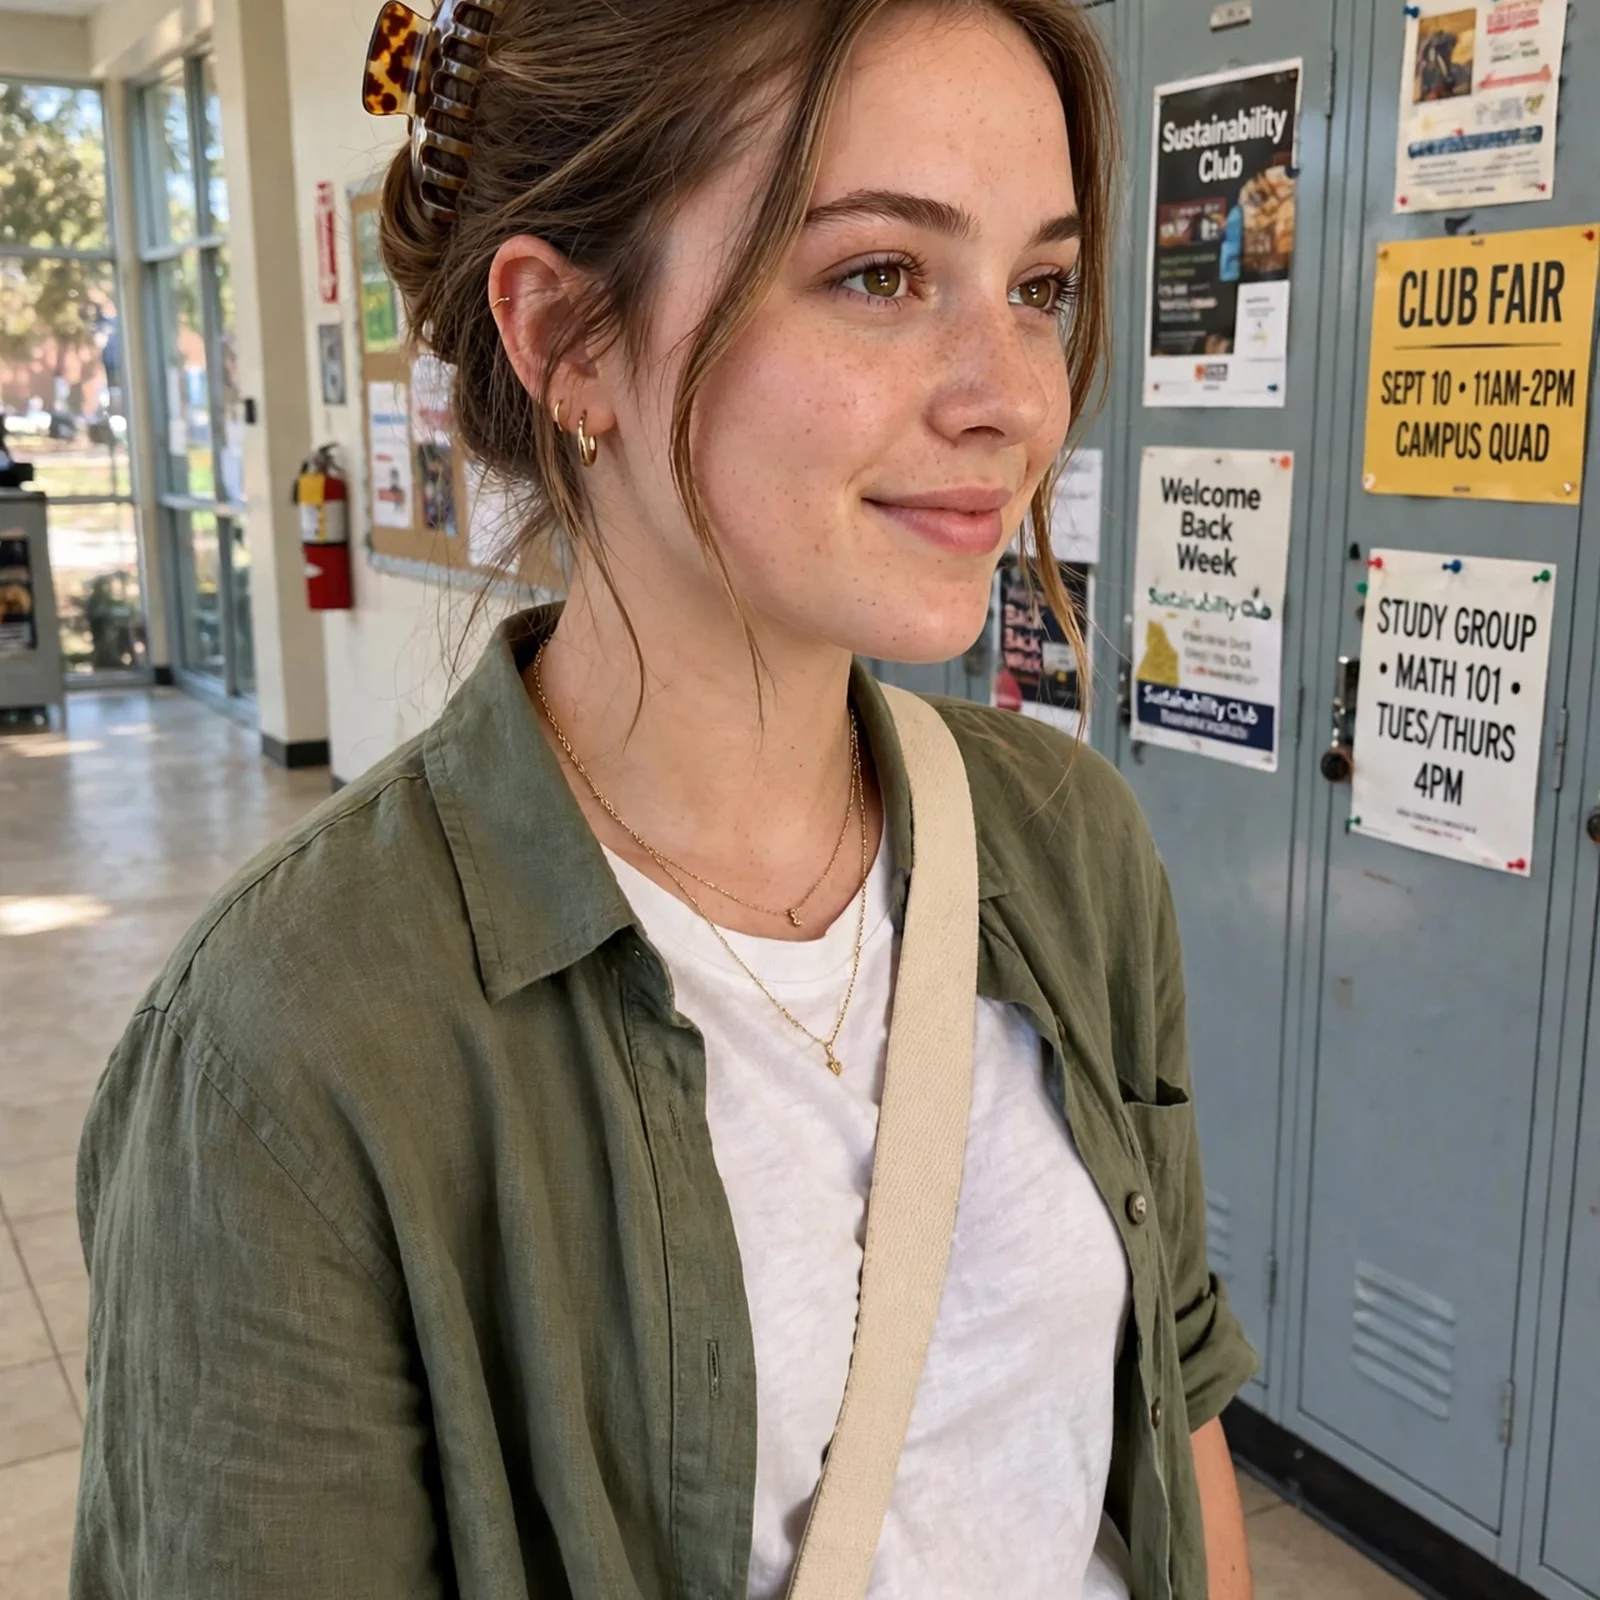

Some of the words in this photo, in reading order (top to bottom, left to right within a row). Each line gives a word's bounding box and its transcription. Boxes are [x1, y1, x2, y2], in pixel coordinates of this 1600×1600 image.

[1161, 104, 1288, 153] Sustainability
[1198, 149, 1244, 183] Club
[1398, 266, 1478, 329] CLUB
[1488, 260, 1565, 325] FAIR
[1380, 370, 1426, 405] SEPT
[1431, 369, 1452, 406] 10
[1474, 368, 1576, 407] 11AM-2PM
[1396, 420, 1482, 460] CAMPUS
[1488, 422, 1550, 464] QUAD
[1161, 477, 1261, 511] Welcome
[1180, 510, 1233, 542] Back
[1177, 543, 1237, 577] Week
[1377, 597, 1448, 641] STUDY
[1454, 606, 1537, 653] GROUP
[1395, 652, 1457, 697] MATH
[1465, 663, 1501, 705] 101
[1377, 702, 1516, 763] TUES/THURS
[1414, 762, 1464, 806] 4PM
